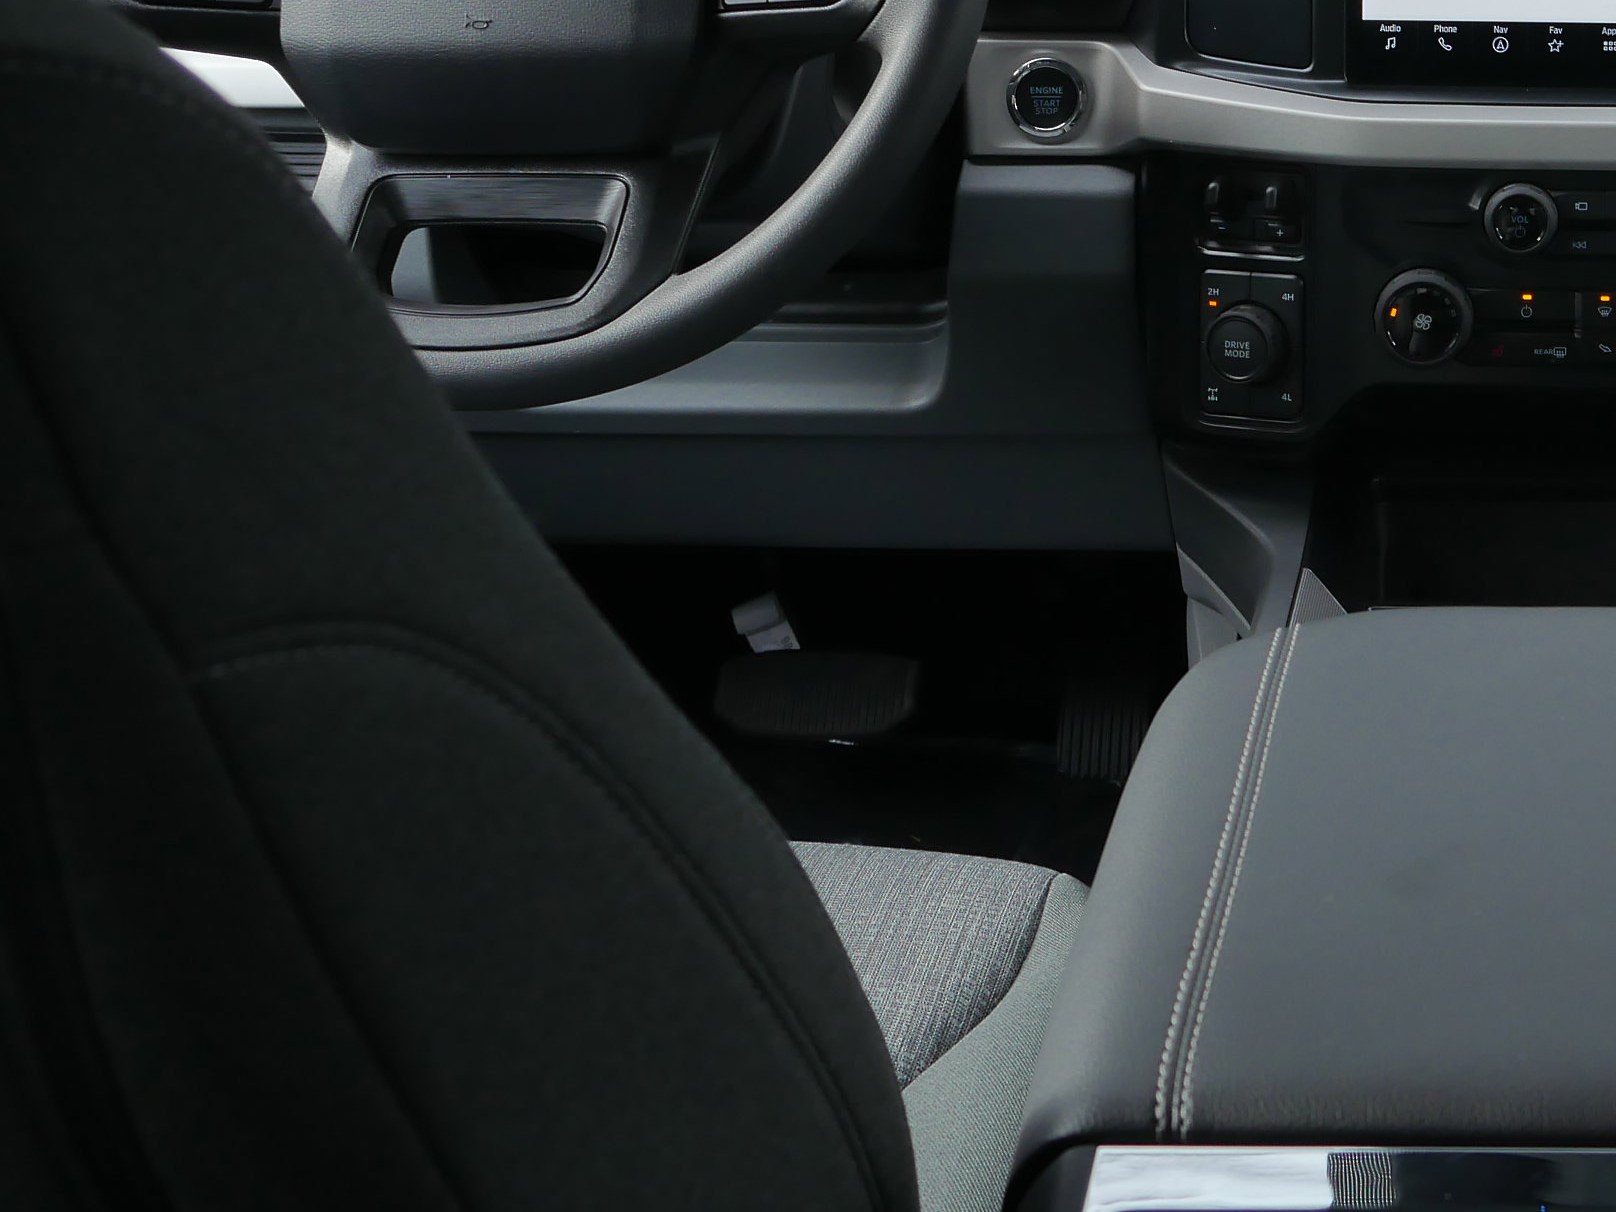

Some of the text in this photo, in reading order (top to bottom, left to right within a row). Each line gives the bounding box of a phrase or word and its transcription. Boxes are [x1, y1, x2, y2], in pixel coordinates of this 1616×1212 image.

[1380, 24, 1401, 33] Audio
[1433, 25, 1457, 33] Phone
[1493, 25, 1508, 34] Nav
[1549, 26, 1563, 35] Fav
[1030, 86, 1064, 95] ENGINE
[1033, 99, 1060, 107] START
[1511, 216, 1529, 224] VOL
[1207, 288, 1220, 296] 2H
[1281, 293, 1294, 302] 4H
[1224, 340, 1250, 350] DRIVE
[1224, 349, 1251, 359] MODE
[1533, 348, 1553, 356] REAR
[1282, 392, 1292, 402] 4L
